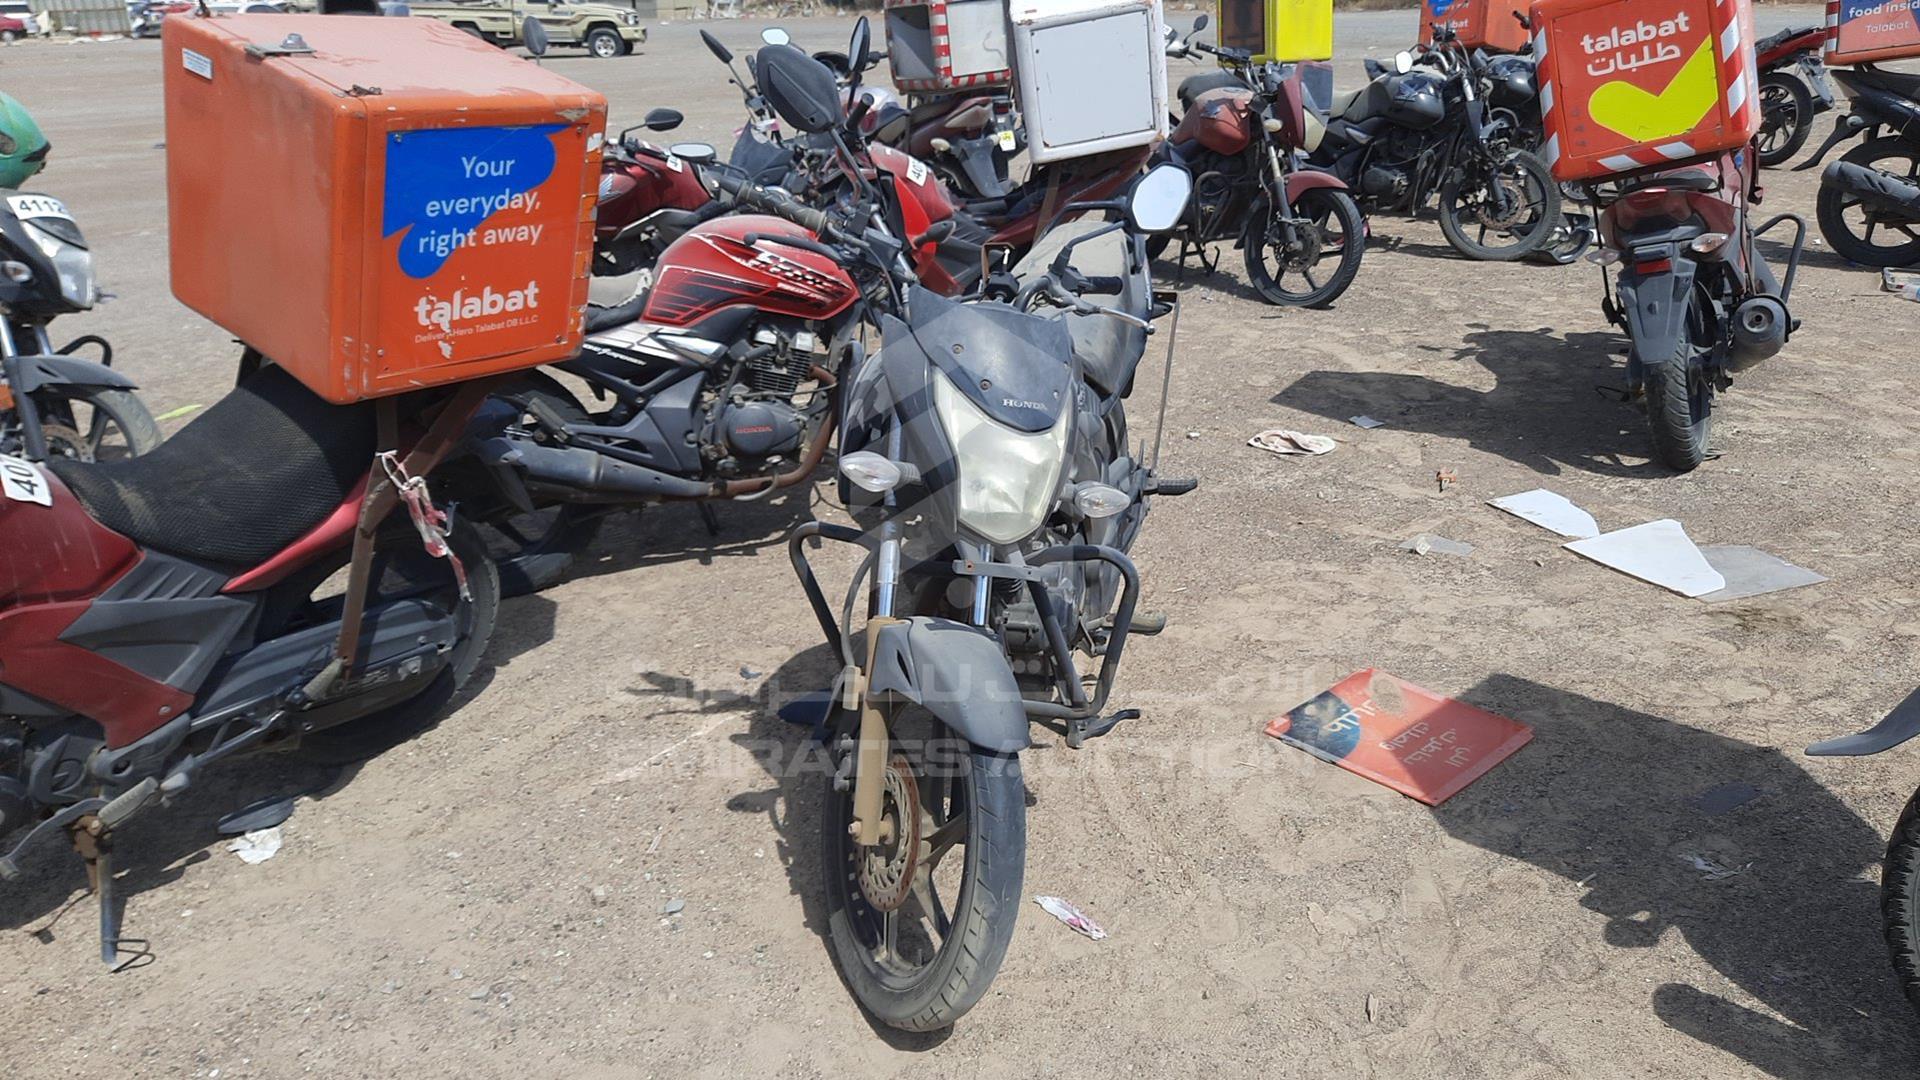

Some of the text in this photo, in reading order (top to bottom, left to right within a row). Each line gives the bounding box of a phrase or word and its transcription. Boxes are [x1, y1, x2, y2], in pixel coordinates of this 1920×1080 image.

[1848, 3, 1882, 18] food
[1580, 11, 1689, 54] talabat
[1865, 20, 1910, 33] Talabat
[1587, 42, 1680, 76] طلبات
[461, 155, 515, 178] Your
[19, 199, 64, 212] 4112
[425, 187, 541, 218] everyday,
[418, 223, 543, 257] right away
[414, 280, 540, 326] talabat
[475, 321, 505, 333] Talabat
[1002, 398, 1049, 411] HONDA
